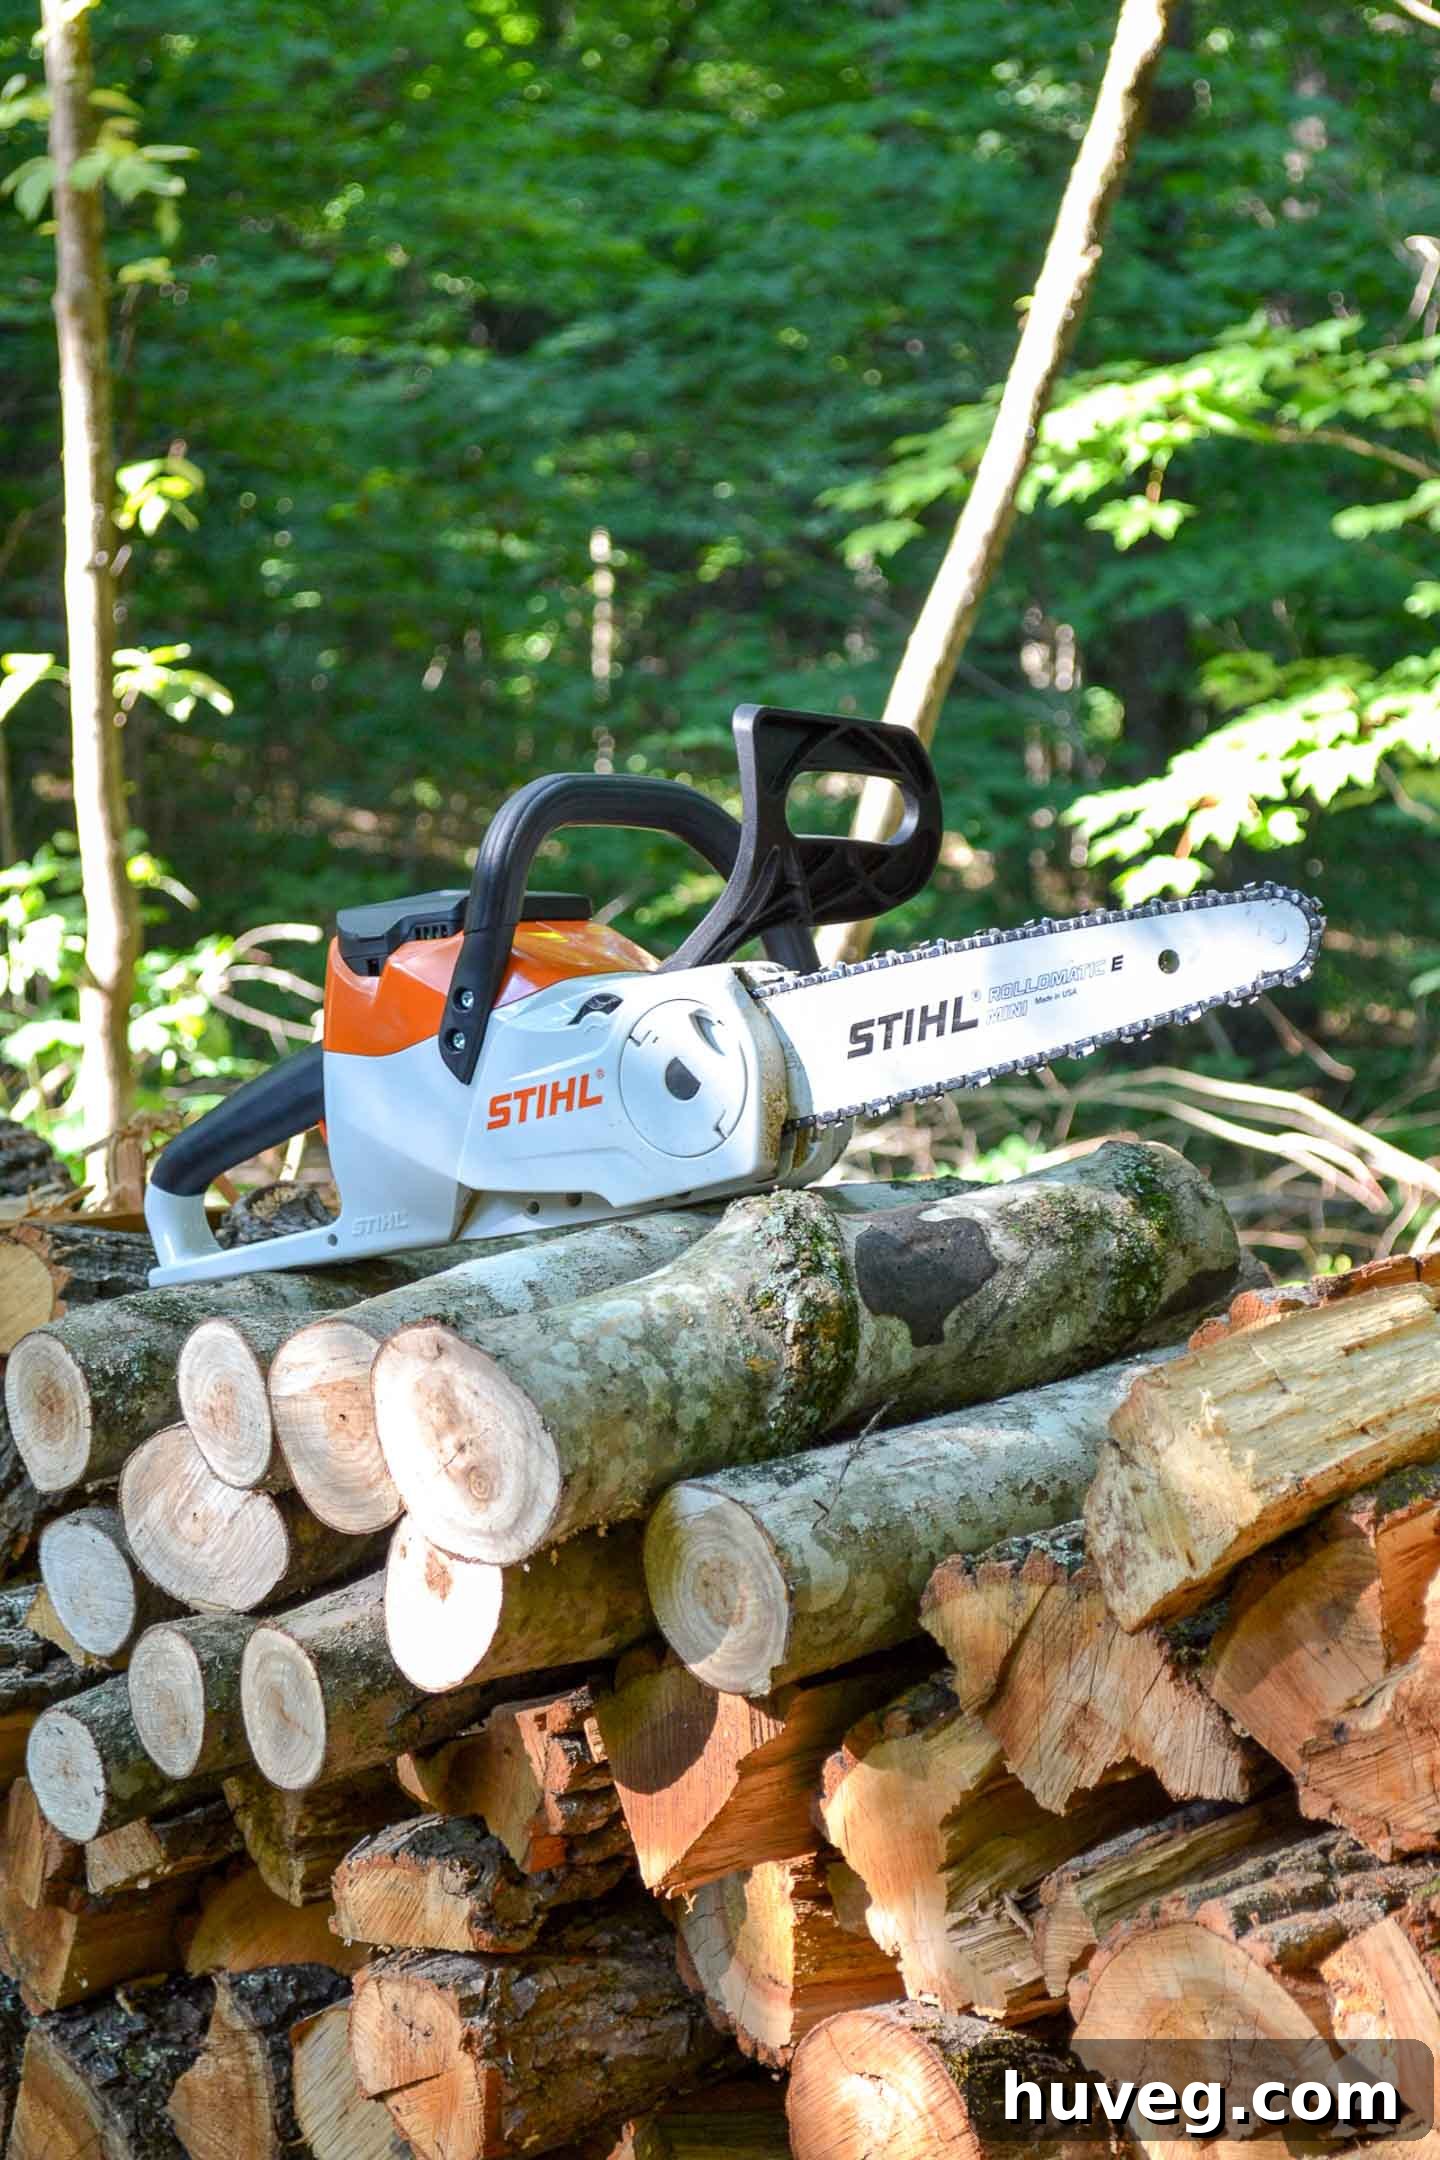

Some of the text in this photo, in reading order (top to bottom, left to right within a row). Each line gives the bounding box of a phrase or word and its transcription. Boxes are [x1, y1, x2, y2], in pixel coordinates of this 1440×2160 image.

[987, 955, 1124, 1003] ROLLOMATIC E
[1062, 987, 1078, 998] USA
[847, 996, 979, 1059] STIHL
[985, 999, 1029, 1025] MINI
[486, 1073, 603, 1130] STIHL
[352, 1211, 409, 1239] STIHL
